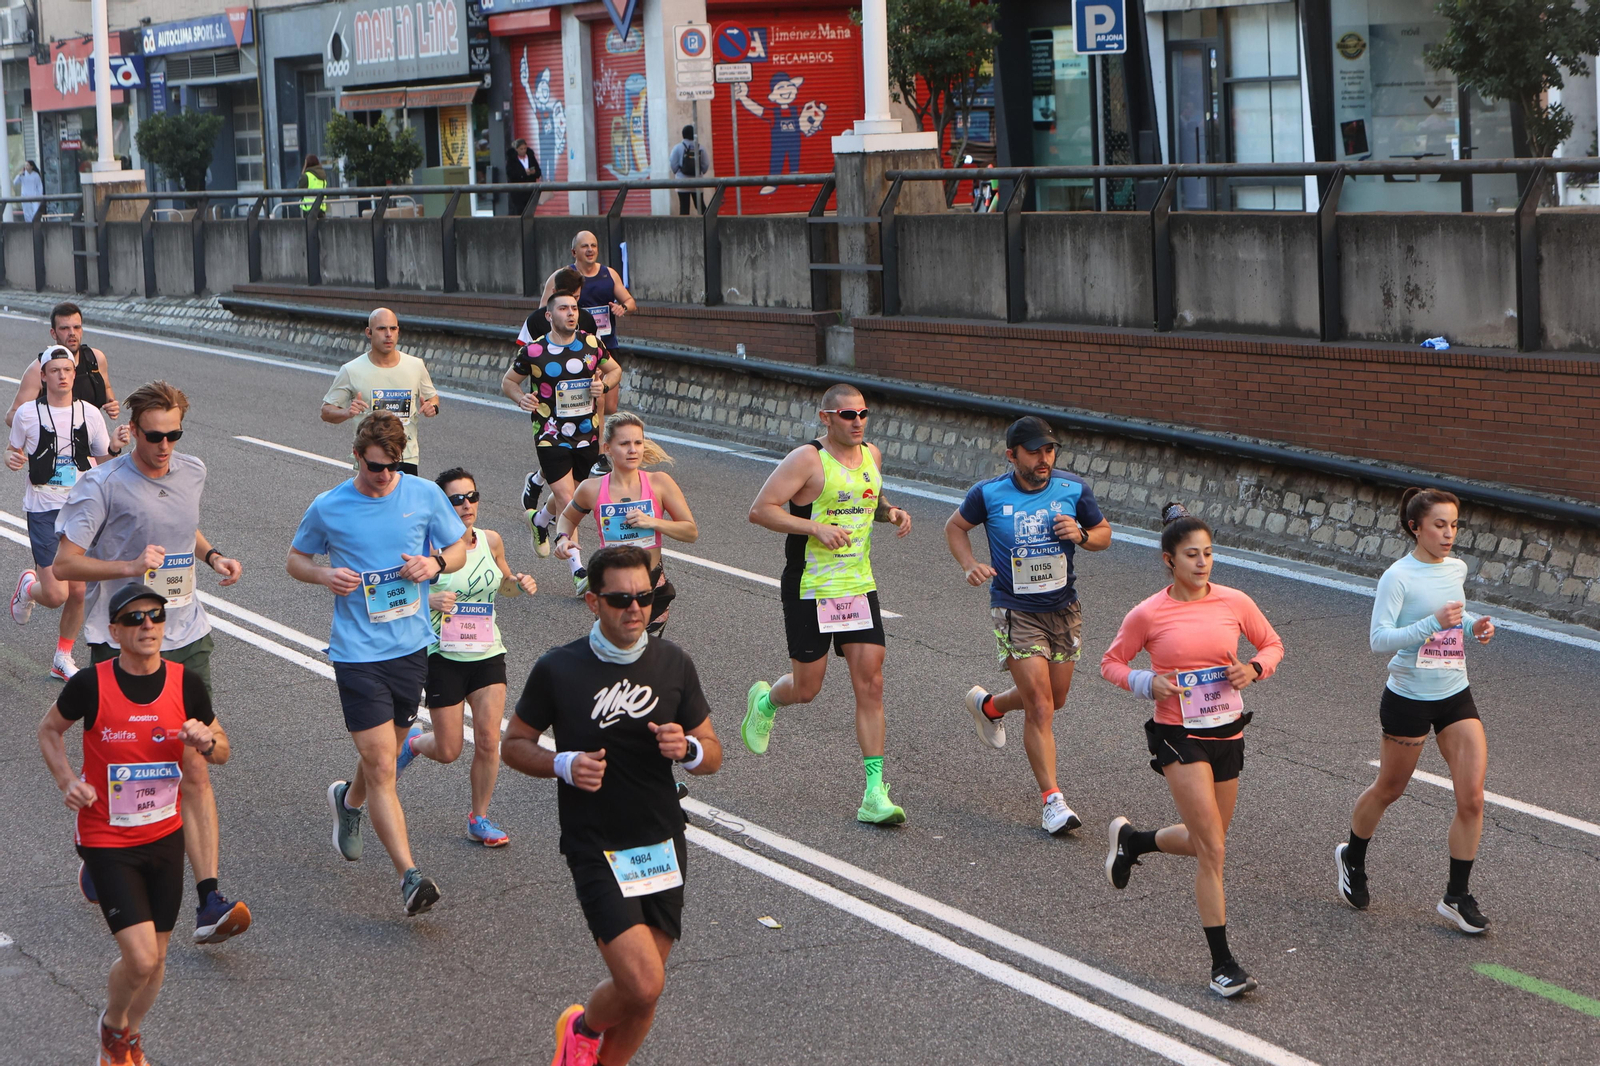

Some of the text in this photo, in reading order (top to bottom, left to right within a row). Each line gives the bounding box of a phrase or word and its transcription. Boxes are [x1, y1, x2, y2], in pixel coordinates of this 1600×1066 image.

[1085, 5, 1116, 49] P
[158, 27, 192, 47] AUTOCLIMA
[193, 24, 214, 42] SPORT,
[216, 23, 226, 39] S.L.
[770, 23, 851, 46] Jiménez Maña
[1096, 34, 1123, 42] ARJONA
[773, 52, 834, 65] RECAMBIOS
[620, 532, 639, 540] LAURA
[1031, 546, 1060, 555] ZURICH
[168, 557, 192, 566] ZURIC
[1030, 563, 1052, 571] 10155
[166, 576, 183, 585] 9884
[384, 571, 401, 581] ZUR
[1030, 573, 1053, 582] ELBALA
[387, 587, 405, 598] 5638
[389, 598, 407, 608] SIEBE
[1423, 649, 1441, 657] ANITA
[1201, 671, 1226, 682] ZURIC
[1200, 703, 1229, 715] MAESTRO
[109, 731, 136, 740] califas
[135, 768, 172, 778] ZURICH
[136, 787, 156, 798] 7765
[137, 801, 156, 811] RAFA
[630, 852, 652, 865] 4984
[640, 869, 647, 878] &
[647, 863, 671, 876] PAULA
